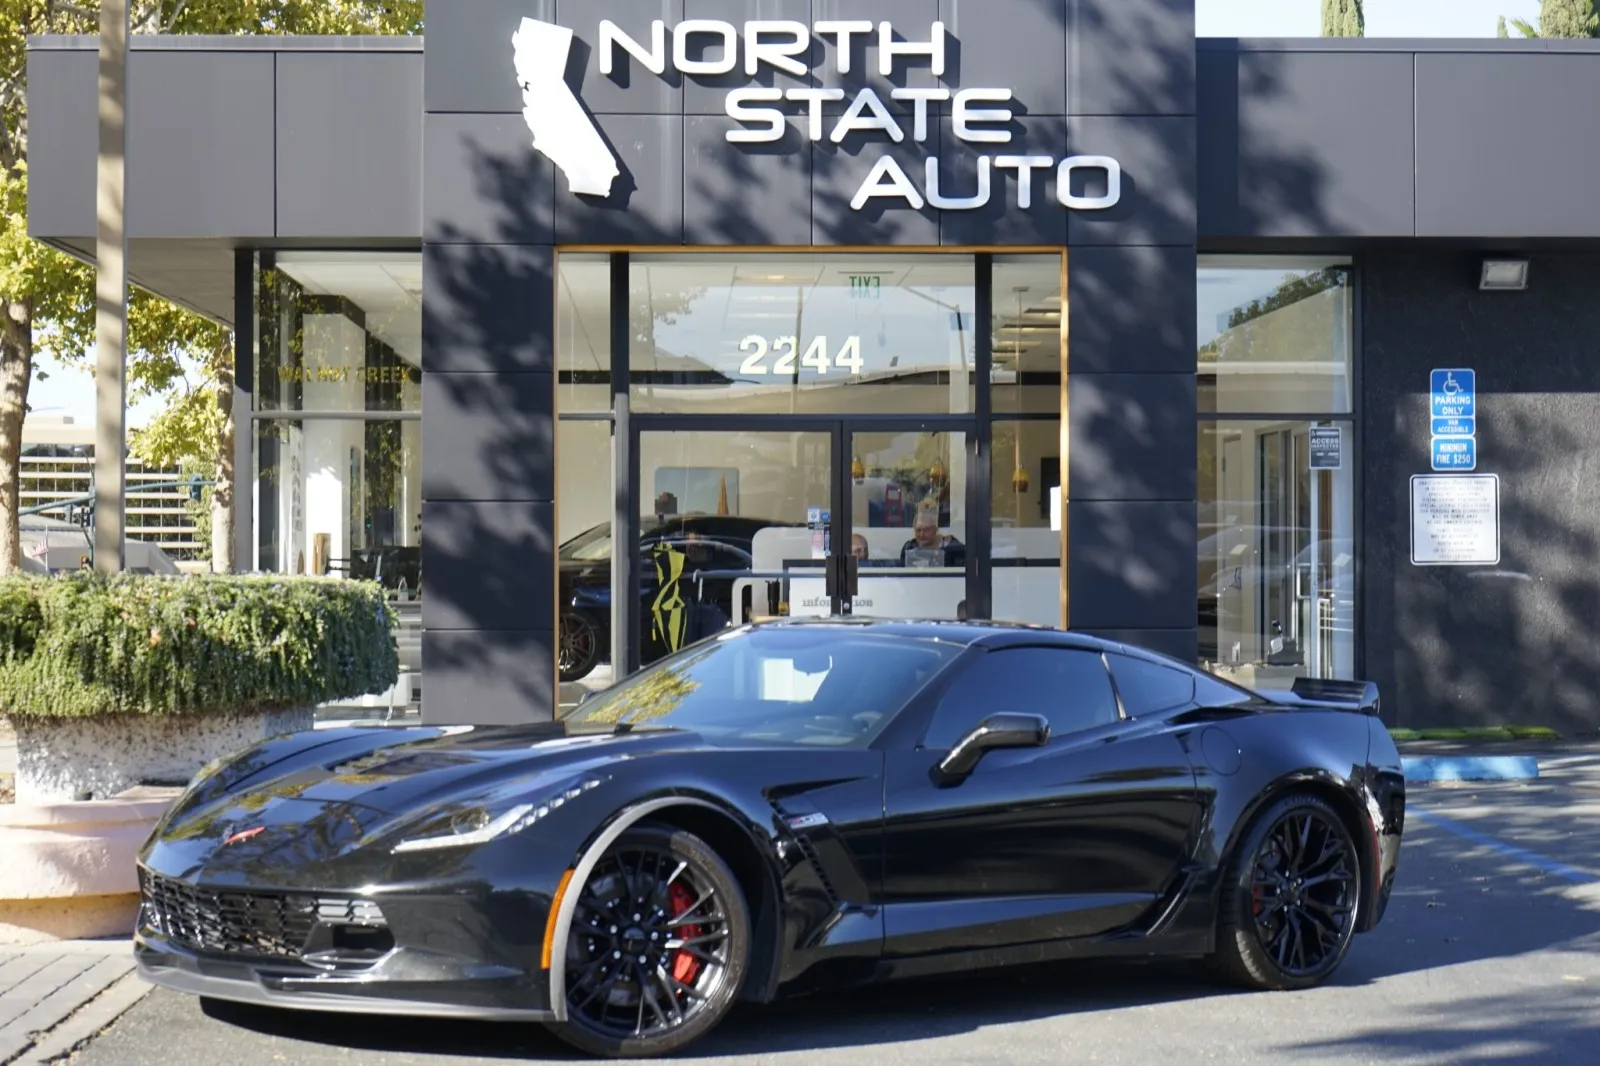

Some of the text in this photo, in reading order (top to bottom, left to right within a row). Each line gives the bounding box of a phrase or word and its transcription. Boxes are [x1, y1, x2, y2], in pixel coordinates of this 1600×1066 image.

[599, 20, 945, 76] NORTH
[725, 87, 1012, 142] STATE
[850, 155, 1121, 210] AUTO
[739, 334, 864, 375] 2244
[278, 365, 351, 383] WALNUT
[1434, 395, 1471, 405] PARKING
[1442, 405, 1464, 415] ONLY
[1437, 425, 1469, 433] ACCESSIBLE
[1439, 442, 1468, 453] MINIMUM
[1436, 453, 1471, 464] FINE $250
